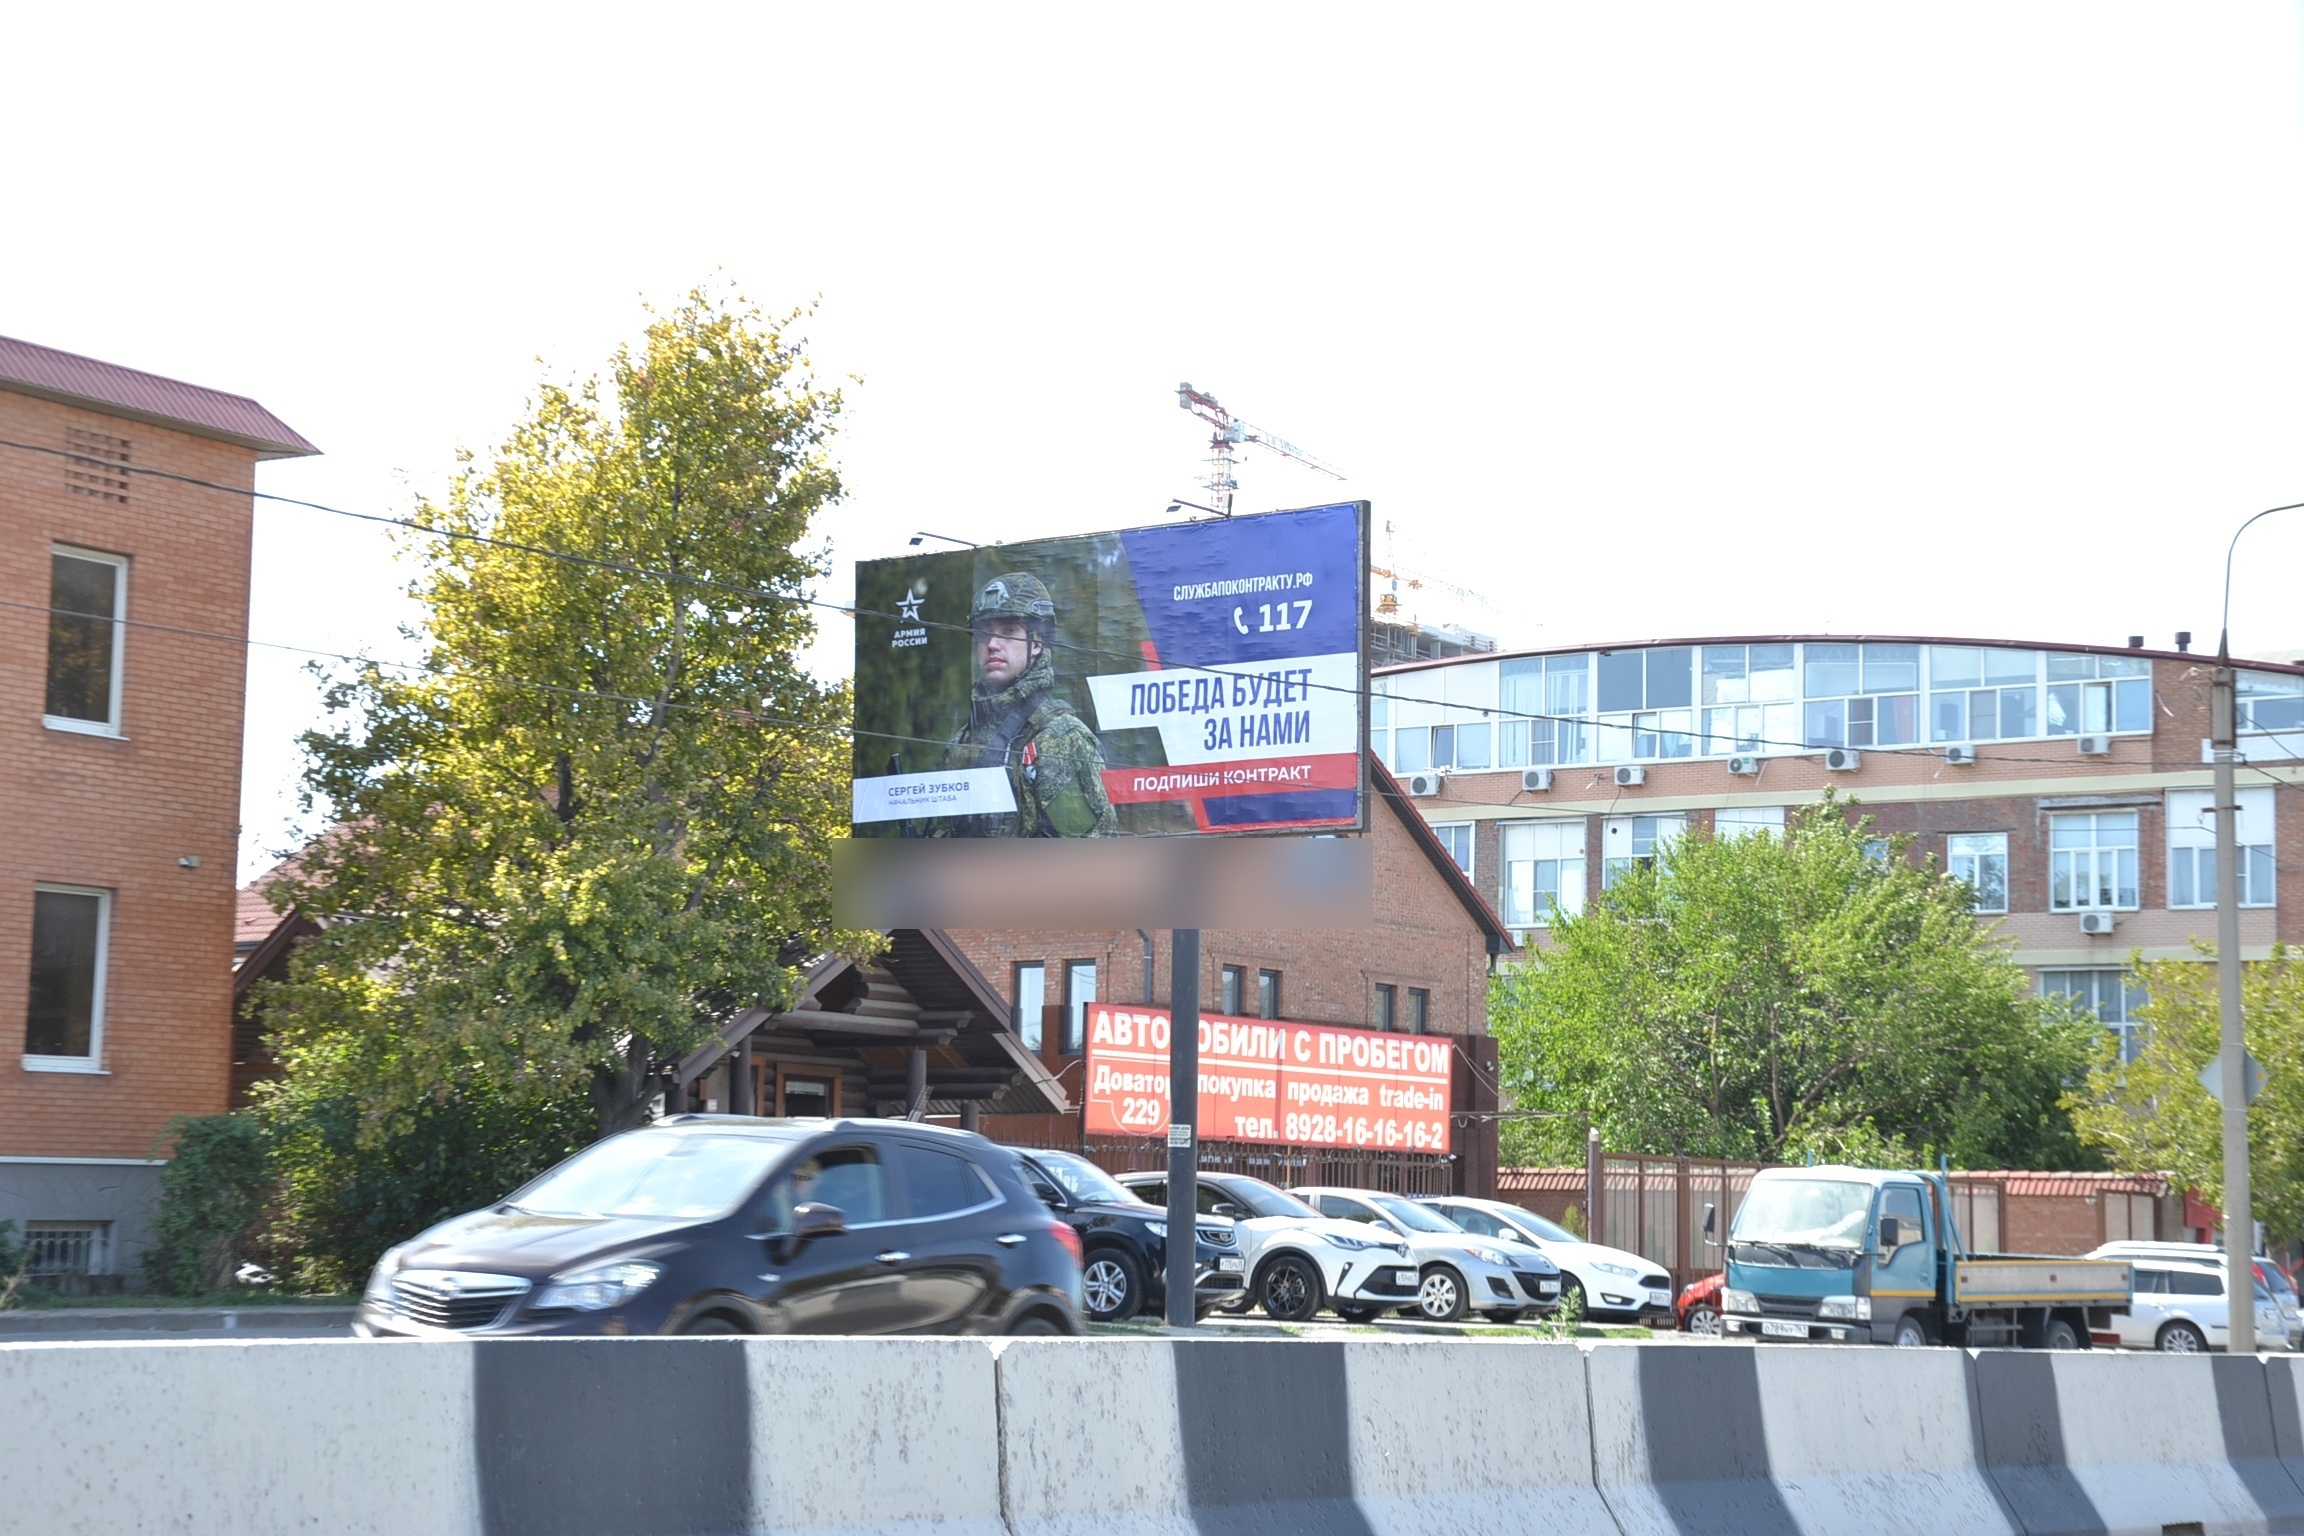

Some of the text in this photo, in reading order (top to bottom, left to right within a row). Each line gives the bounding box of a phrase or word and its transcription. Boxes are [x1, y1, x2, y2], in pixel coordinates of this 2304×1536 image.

[1173, 572, 1313, 601] СЛУЖБАПОКОНТРАКТУ.РФ
[1259, 600, 1313, 632] 117
[892, 637, 928, 648] РОССИИ
[894, 628, 926, 639] АРМИЯ
[1130, 668, 1312, 716] ПОБЕДА БУДЕТ
[1204, 710, 1310, 750] ЗА НАМИ
[888, 781, 970, 797] СЕРГЕЙ ЗУБКОВ
[1133, 765, 1311, 792] ПОДПИШИ КОНТРАКТ
[888, 795, 957, 806] НАЧАЛЬНИК ШТАБА
[1092, 1011, 1448, 1074] АВТООБИЛИ С ПРОБЕГОМ
[1197, 1073, 1443, 1111] покупка продажа trade-in
[1121, 1097, 1161, 1125] 229
[1234, 1112, 1443, 1149] тел. 8928-16-16-16-2
